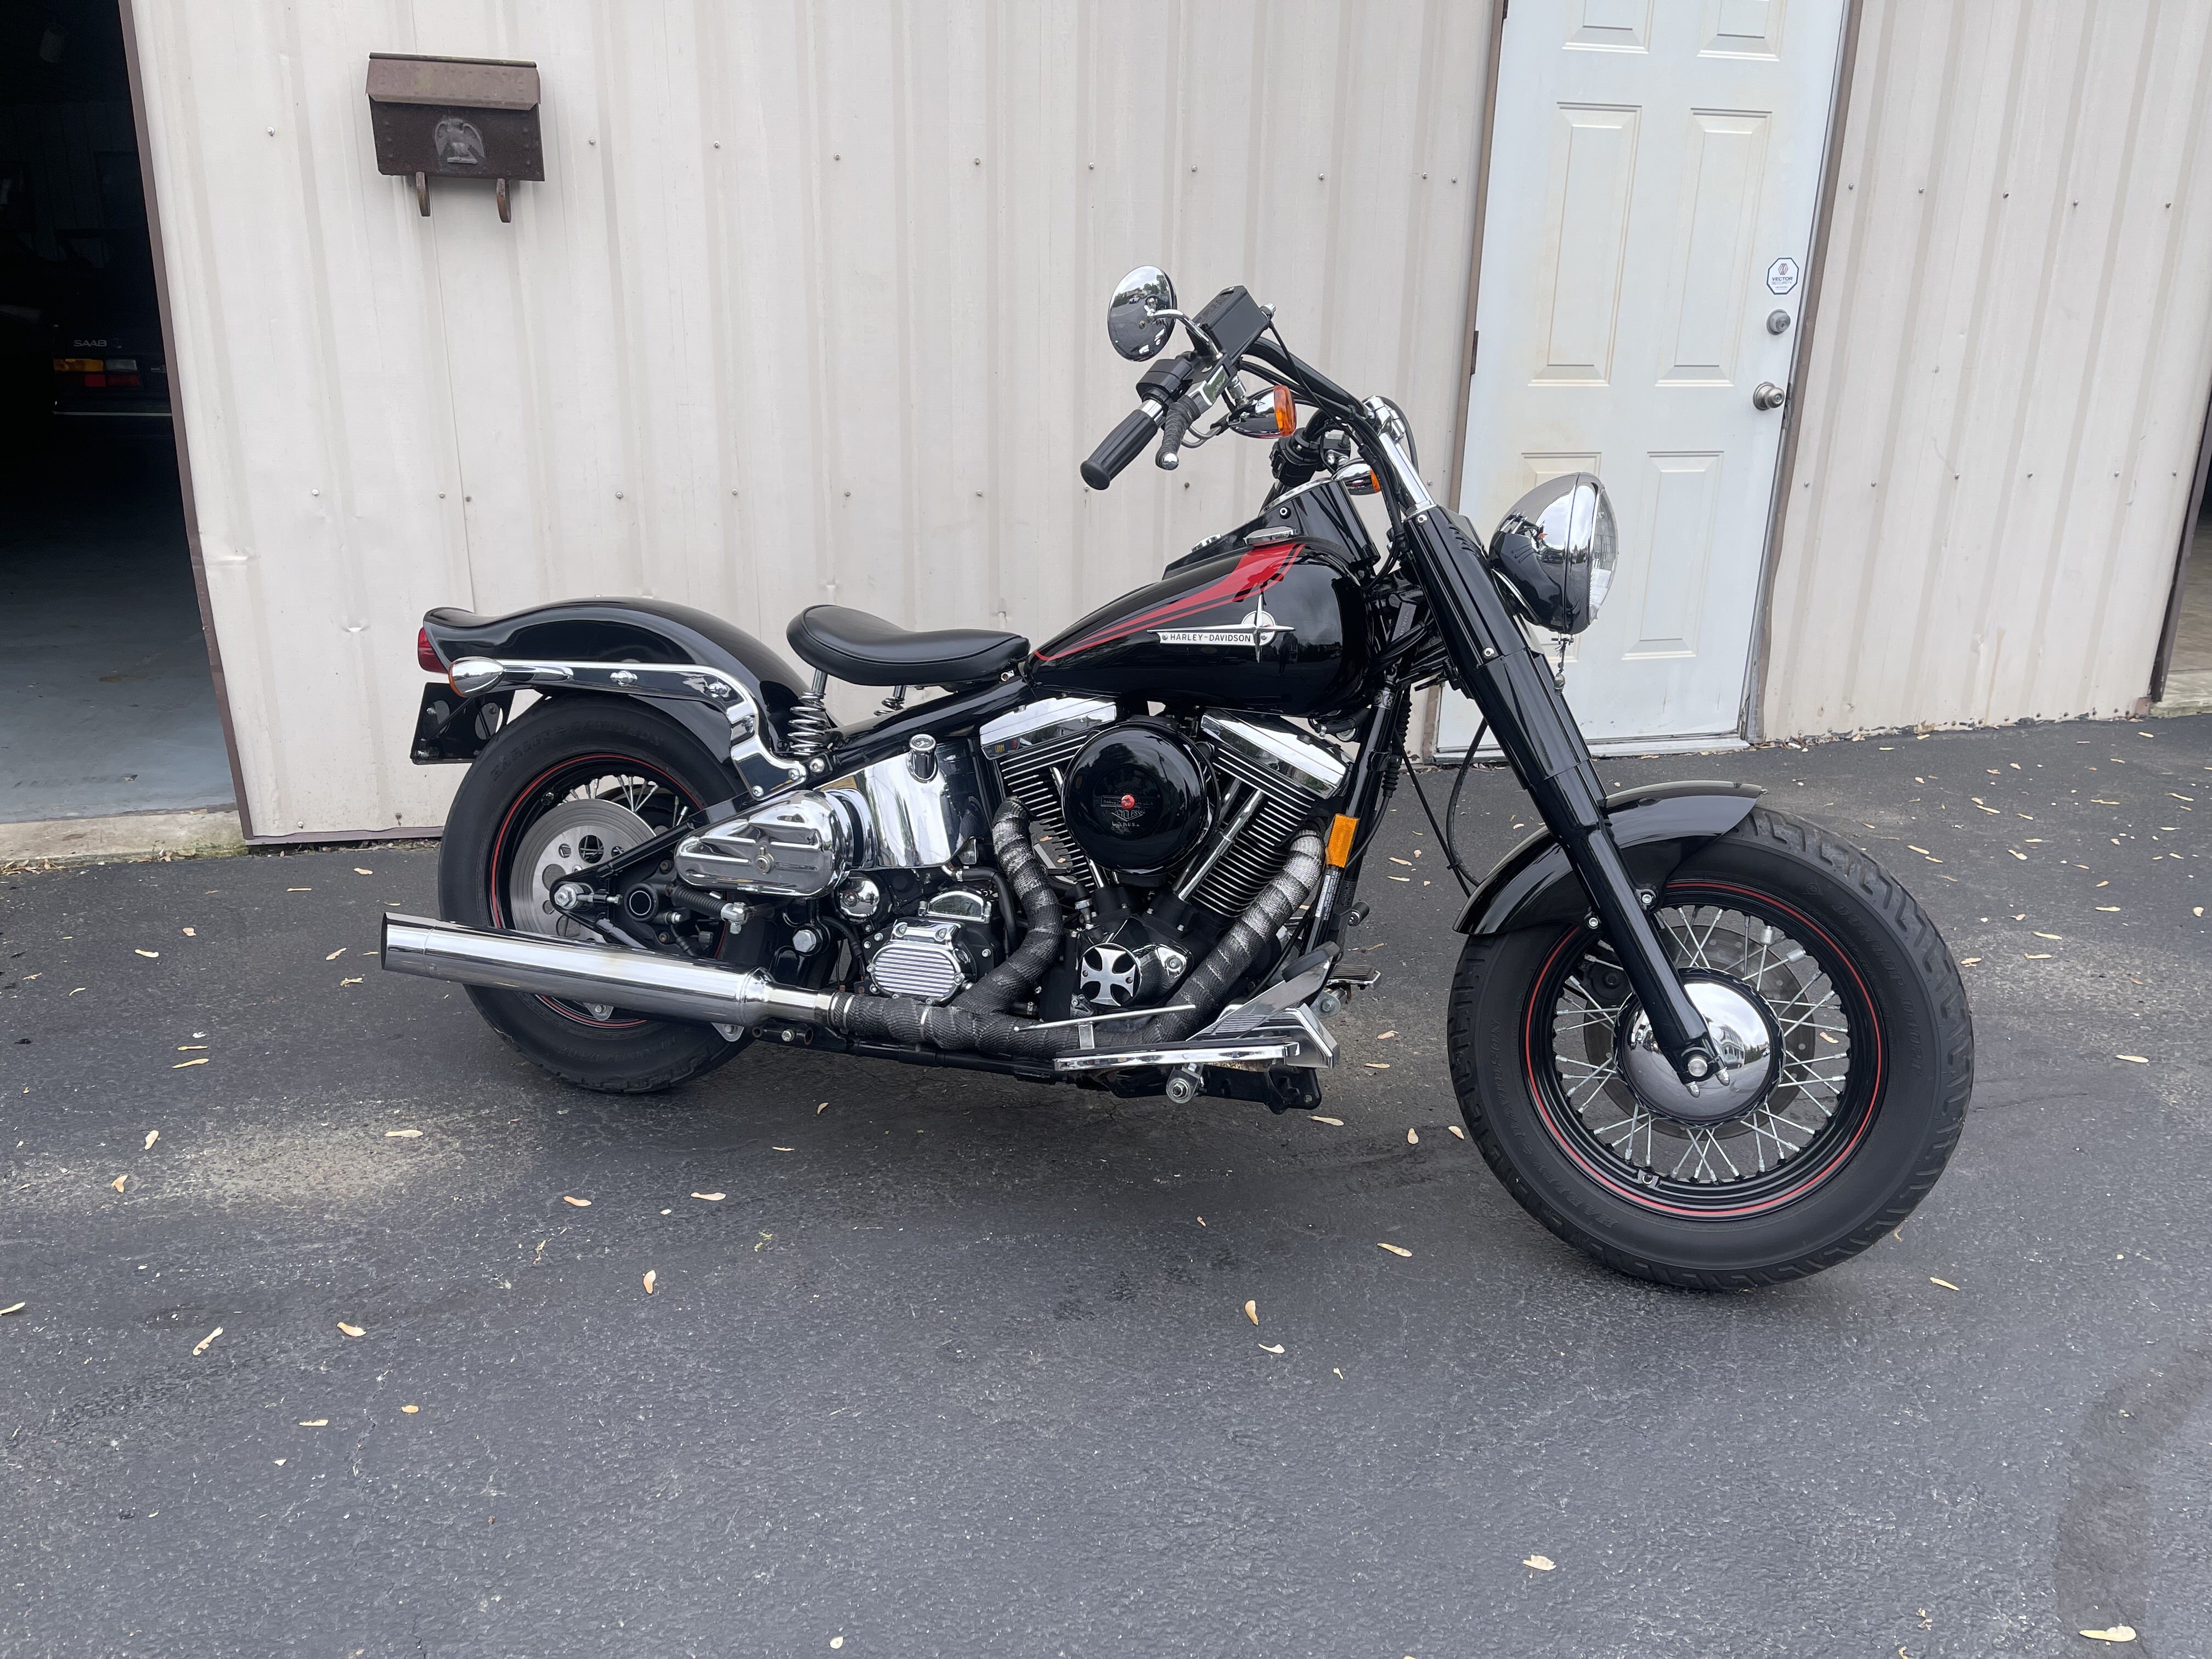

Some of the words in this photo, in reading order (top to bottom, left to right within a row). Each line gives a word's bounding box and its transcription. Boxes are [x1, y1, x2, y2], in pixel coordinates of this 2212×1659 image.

[1170, 634, 1250, 642] HARLEY-DAVIDSON
[1830, 901, 1905, 988] DUNLOP
[1489, 1019, 1526, 1137] DAVIDSON
[1533, 1159, 1618, 1229] HARLEY
